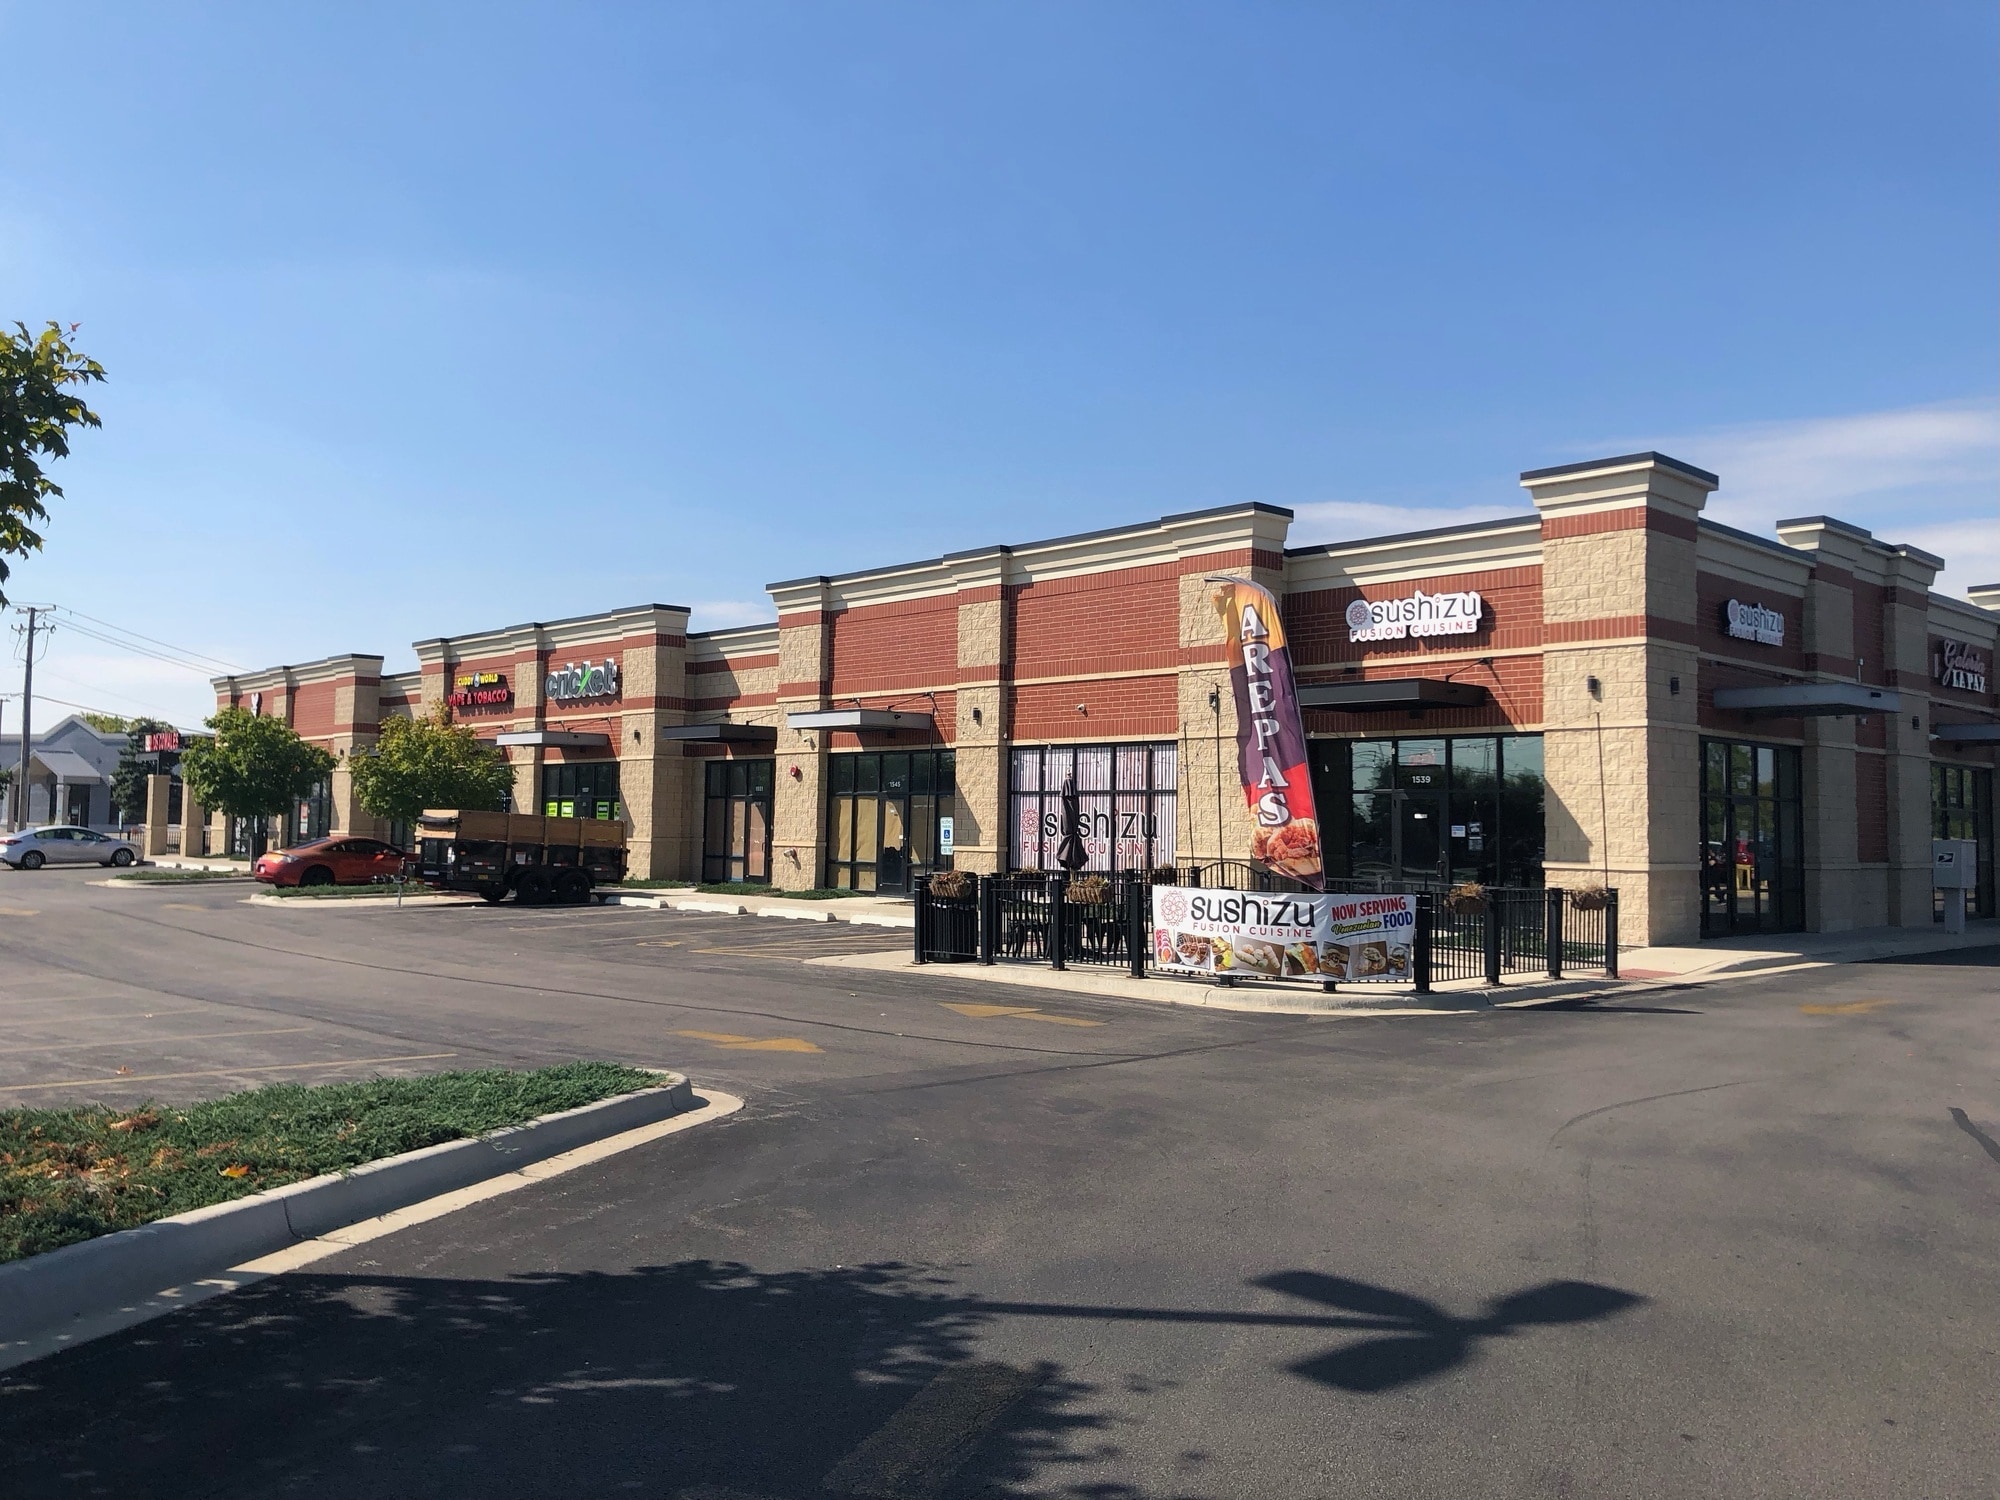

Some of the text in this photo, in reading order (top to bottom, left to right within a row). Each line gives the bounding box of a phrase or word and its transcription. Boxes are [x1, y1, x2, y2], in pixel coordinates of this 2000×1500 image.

[1372, 596, 1477, 624] sushizu
[1740, 602, 1783, 633] sushizu
[1352, 620, 1473, 638] FUSION CUISINE
[479, 673, 498, 684] WORLD
[545, 658, 617, 699] cricket
[1952, 669, 1985, 693] LA PAZ
[448, 694, 465, 706] VAPE
[473, 689, 507, 704] TOBACCO
[1240, 604, 1292, 827] AREPAS
[1191, 893, 1315, 928] sushizu
[1332, 896, 1407, 921] NOW SERVING
[1193, 922, 1312, 937] FUSION CUISINE
[1331, 911, 1413, 935] Venezuelan FOOD
